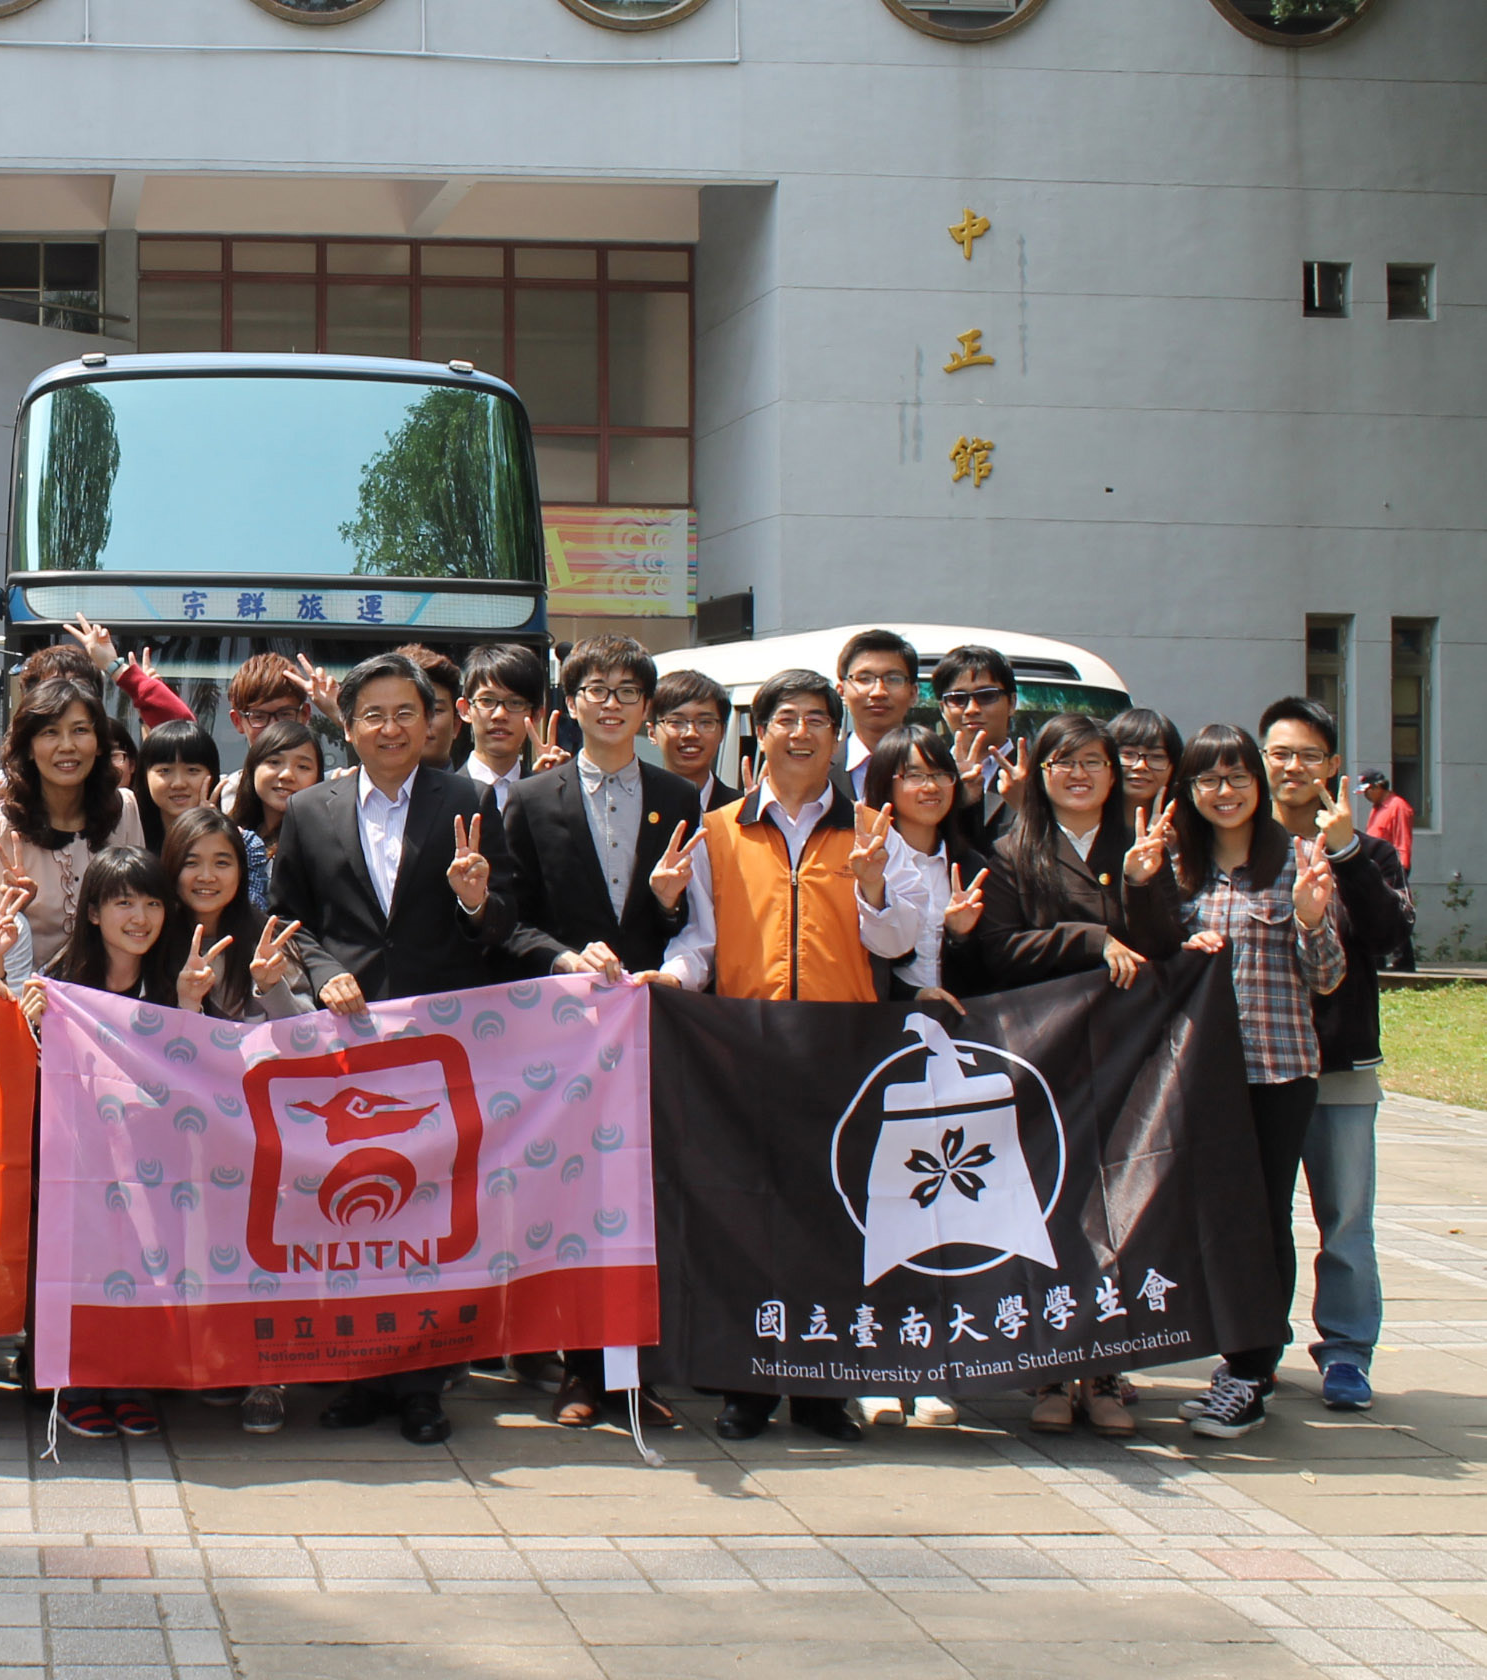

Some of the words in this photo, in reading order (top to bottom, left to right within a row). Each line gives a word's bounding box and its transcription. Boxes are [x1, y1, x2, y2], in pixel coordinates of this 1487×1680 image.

[943, 208, 995, 487] 中正館
[181, 591, 385, 624] 宗群旅運
[293, 1239, 430, 1274] NUTN
[755, 1268, 1178, 1349] 國立臺南大學學生會
[258, 1350, 319, 1362] National
[326, 1344, 400, 1358] University
[408, 1342, 422, 1353] of
[430, 1335, 473, 1349] Tainan
[752, 1358, 825, 1379] National
[830, 1363, 922, 1383] University
[927, 1364, 947, 1381] of
[949, 1360, 1013, 1378] Tainan
[1018, 1346, 1083, 1369] Student
[1090, 1328, 1191, 1358] Association
